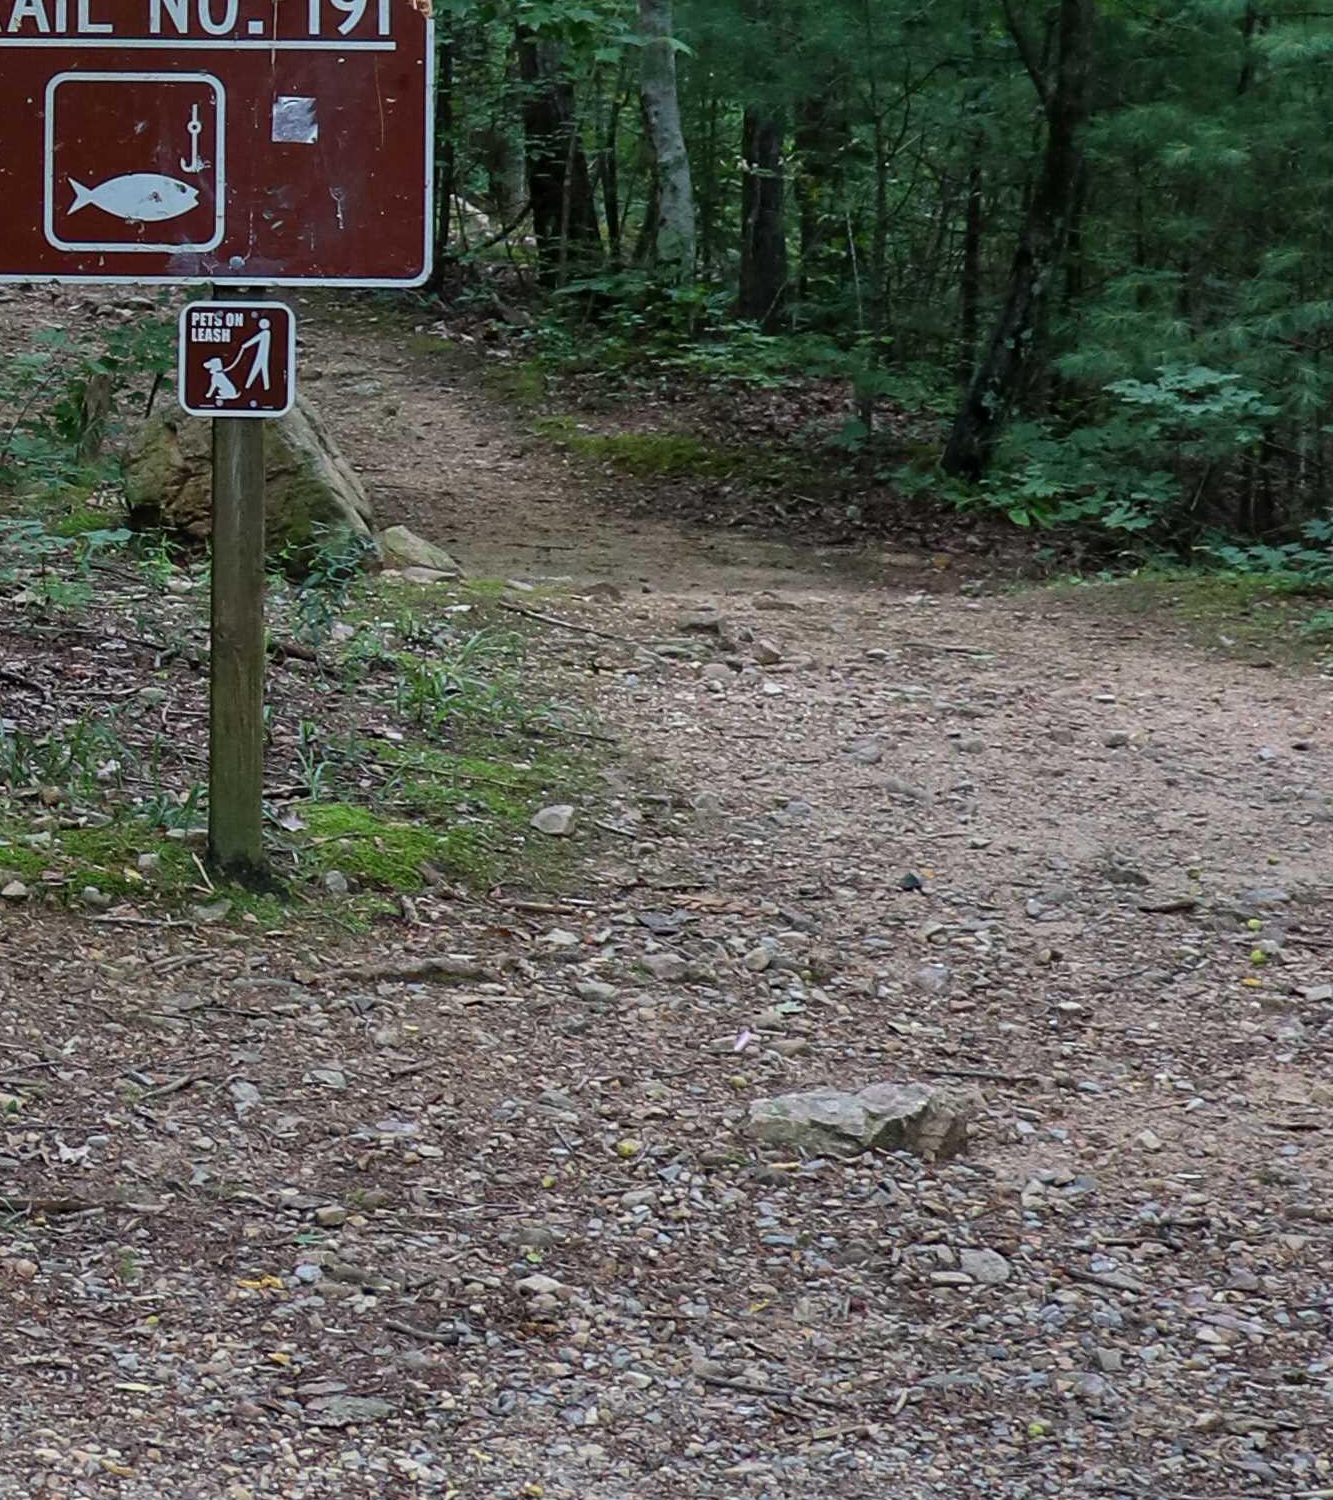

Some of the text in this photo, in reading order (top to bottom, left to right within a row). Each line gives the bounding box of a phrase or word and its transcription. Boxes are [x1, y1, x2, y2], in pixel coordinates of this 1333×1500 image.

[191, 312, 244, 327] PETS ON
[191, 328, 231, 342] LEASH
